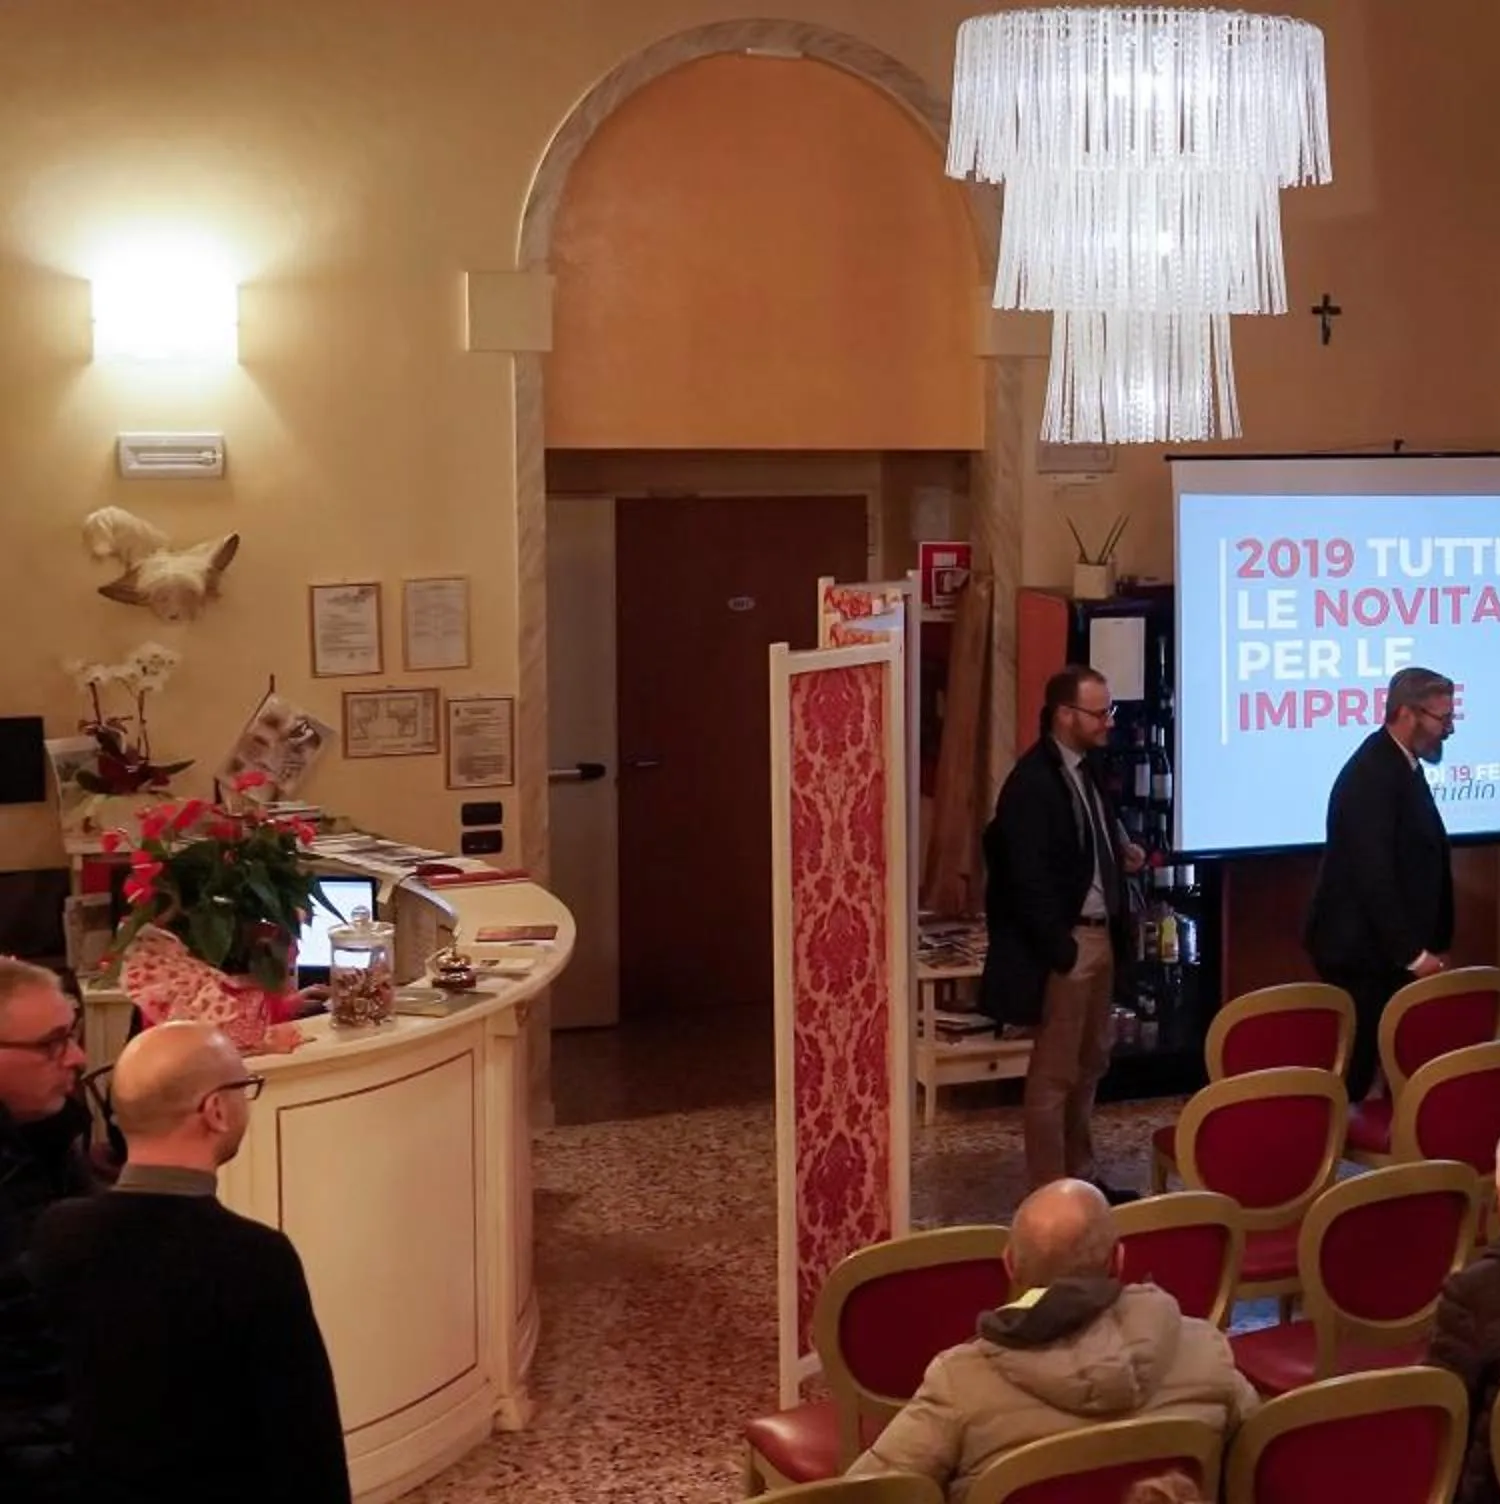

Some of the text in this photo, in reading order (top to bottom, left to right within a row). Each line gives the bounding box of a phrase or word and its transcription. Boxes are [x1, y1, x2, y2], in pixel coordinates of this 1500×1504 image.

[1236, 538, 1355, 579] 2019
[1237, 589, 1298, 630] LE
[1237, 637, 1416, 681] PER LE
[1239, 684, 1465, 731] IMPRE
[1432, 778, 1496, 801] tudio
[1451, 765, 1471, 782] 19
